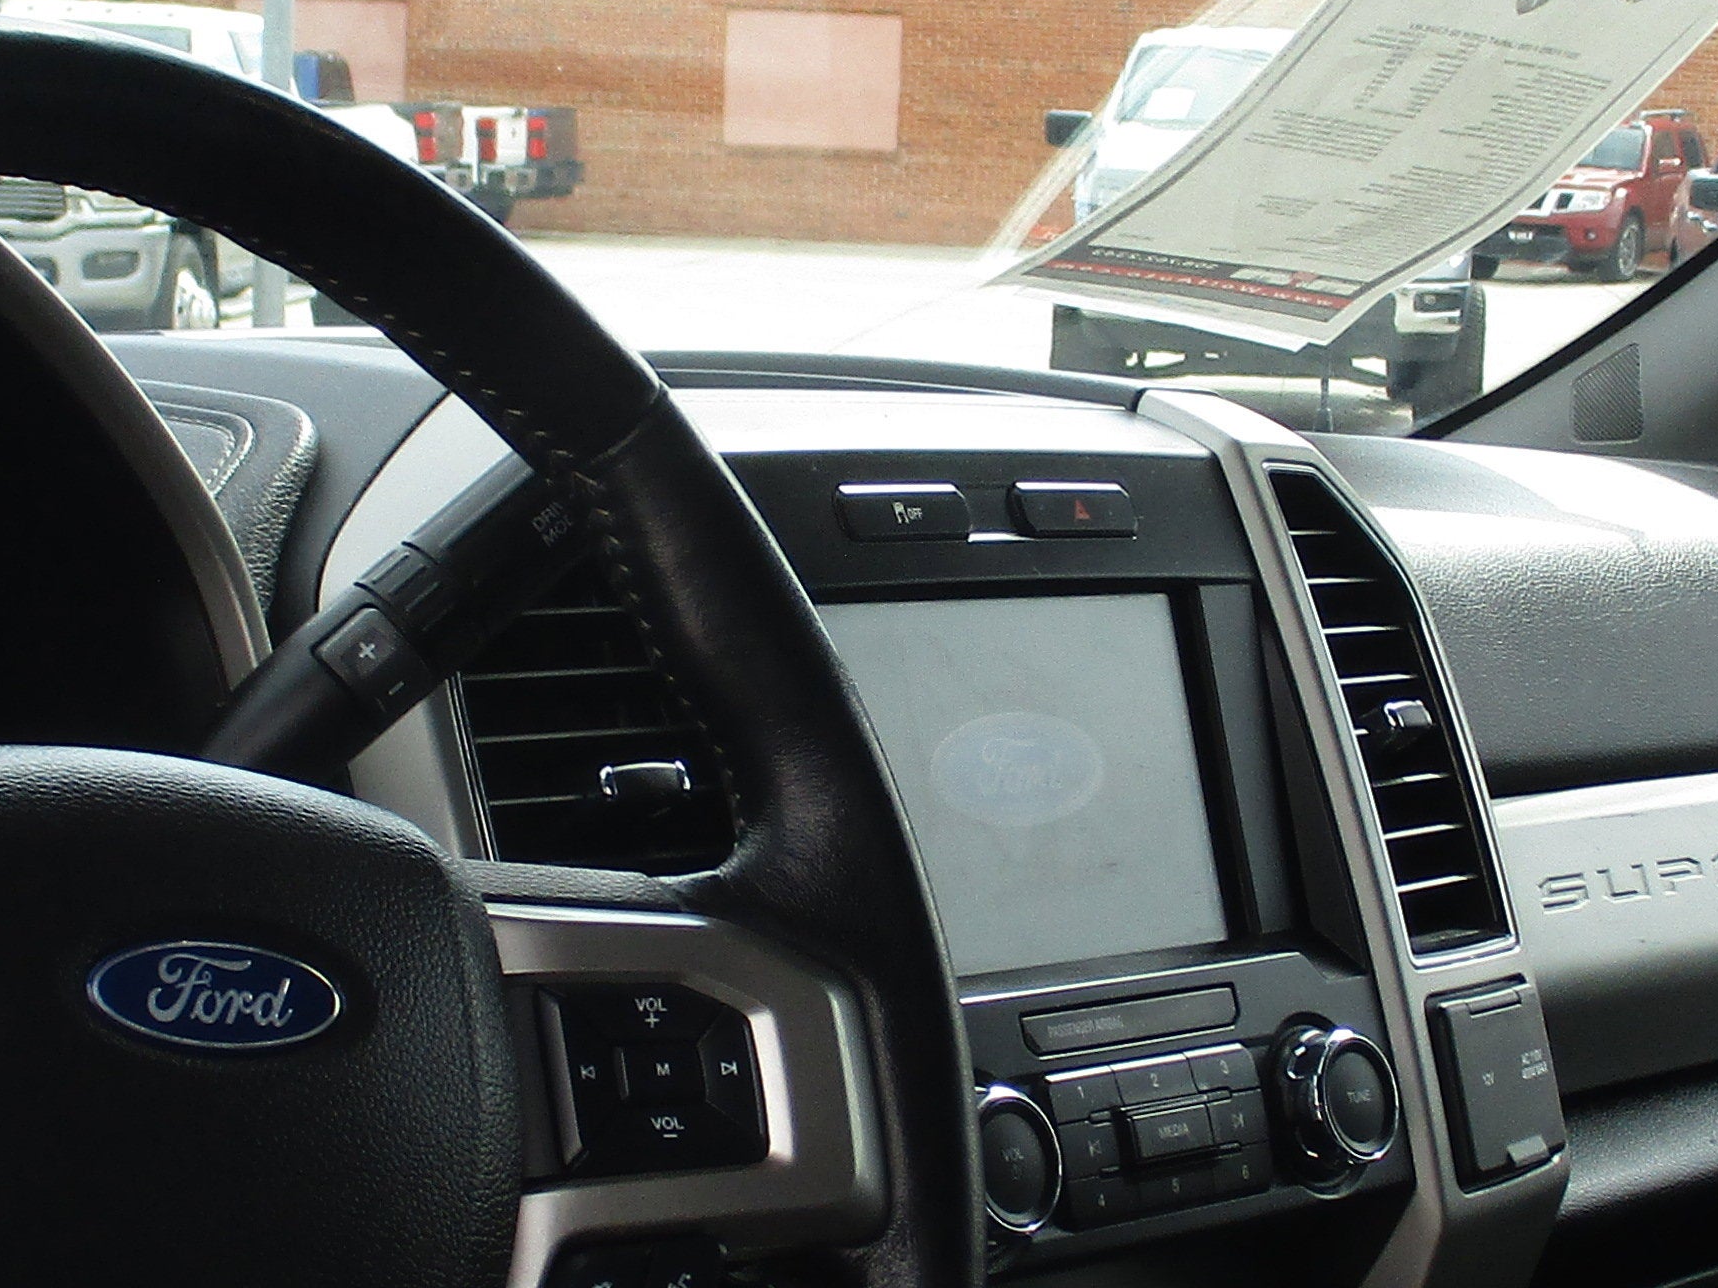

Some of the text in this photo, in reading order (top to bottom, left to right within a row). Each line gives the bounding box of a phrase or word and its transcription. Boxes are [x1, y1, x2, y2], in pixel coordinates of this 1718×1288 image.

[147, 951, 296, 1030] Ford
[634, 997, 667, 1014] VOL
[656, 1062, 670, 1076] M
[1150, 1074, 1160, 1088] 2
[651, 1116, 684, 1132] VOL
[1158, 1122, 1191, 1140] MEDIA
[1000, 1146, 1027, 1165] VOL
[1241, 1165, 1250, 1180] 6
